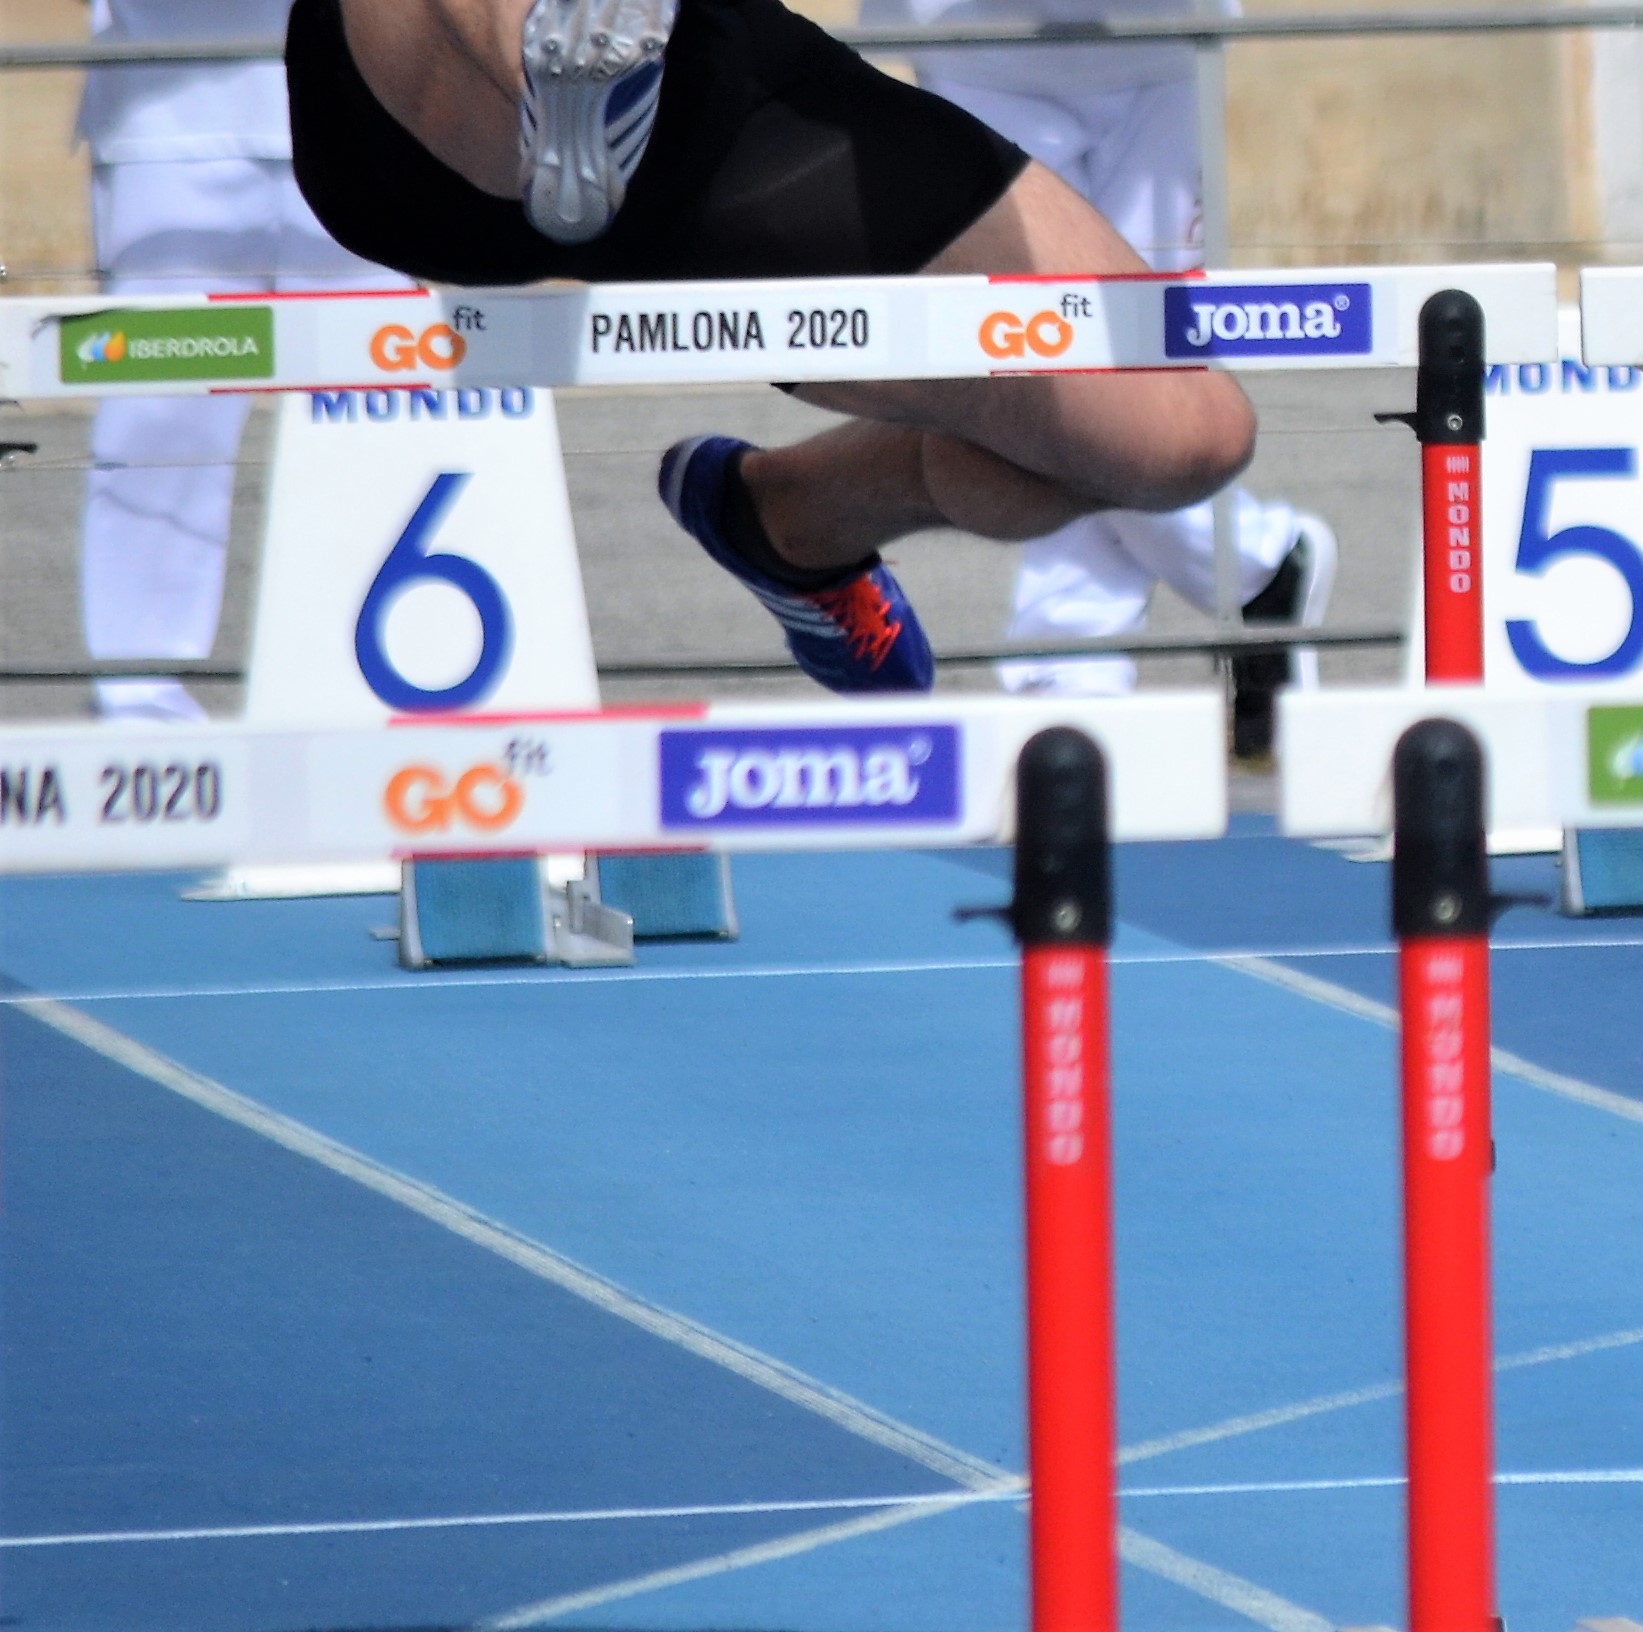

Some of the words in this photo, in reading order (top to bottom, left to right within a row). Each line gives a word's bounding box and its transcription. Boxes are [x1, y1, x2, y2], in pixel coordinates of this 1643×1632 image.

[129, 335, 259, 360] IBERDROLA
[369, 323, 467, 372] GO
[453, 306, 486, 332] fit
[591, 311, 766, 353] PAMLONA
[788, 308, 870, 348] 2020
[978, 310, 1074, 360] GO
[1060, 294, 1093, 318] fit
[1448, 481, 1472, 594] MONDO
[355, 472, 517, 715] 6
[100, 760, 222, 823] 2020
[383, 759, 524, 834] GO
